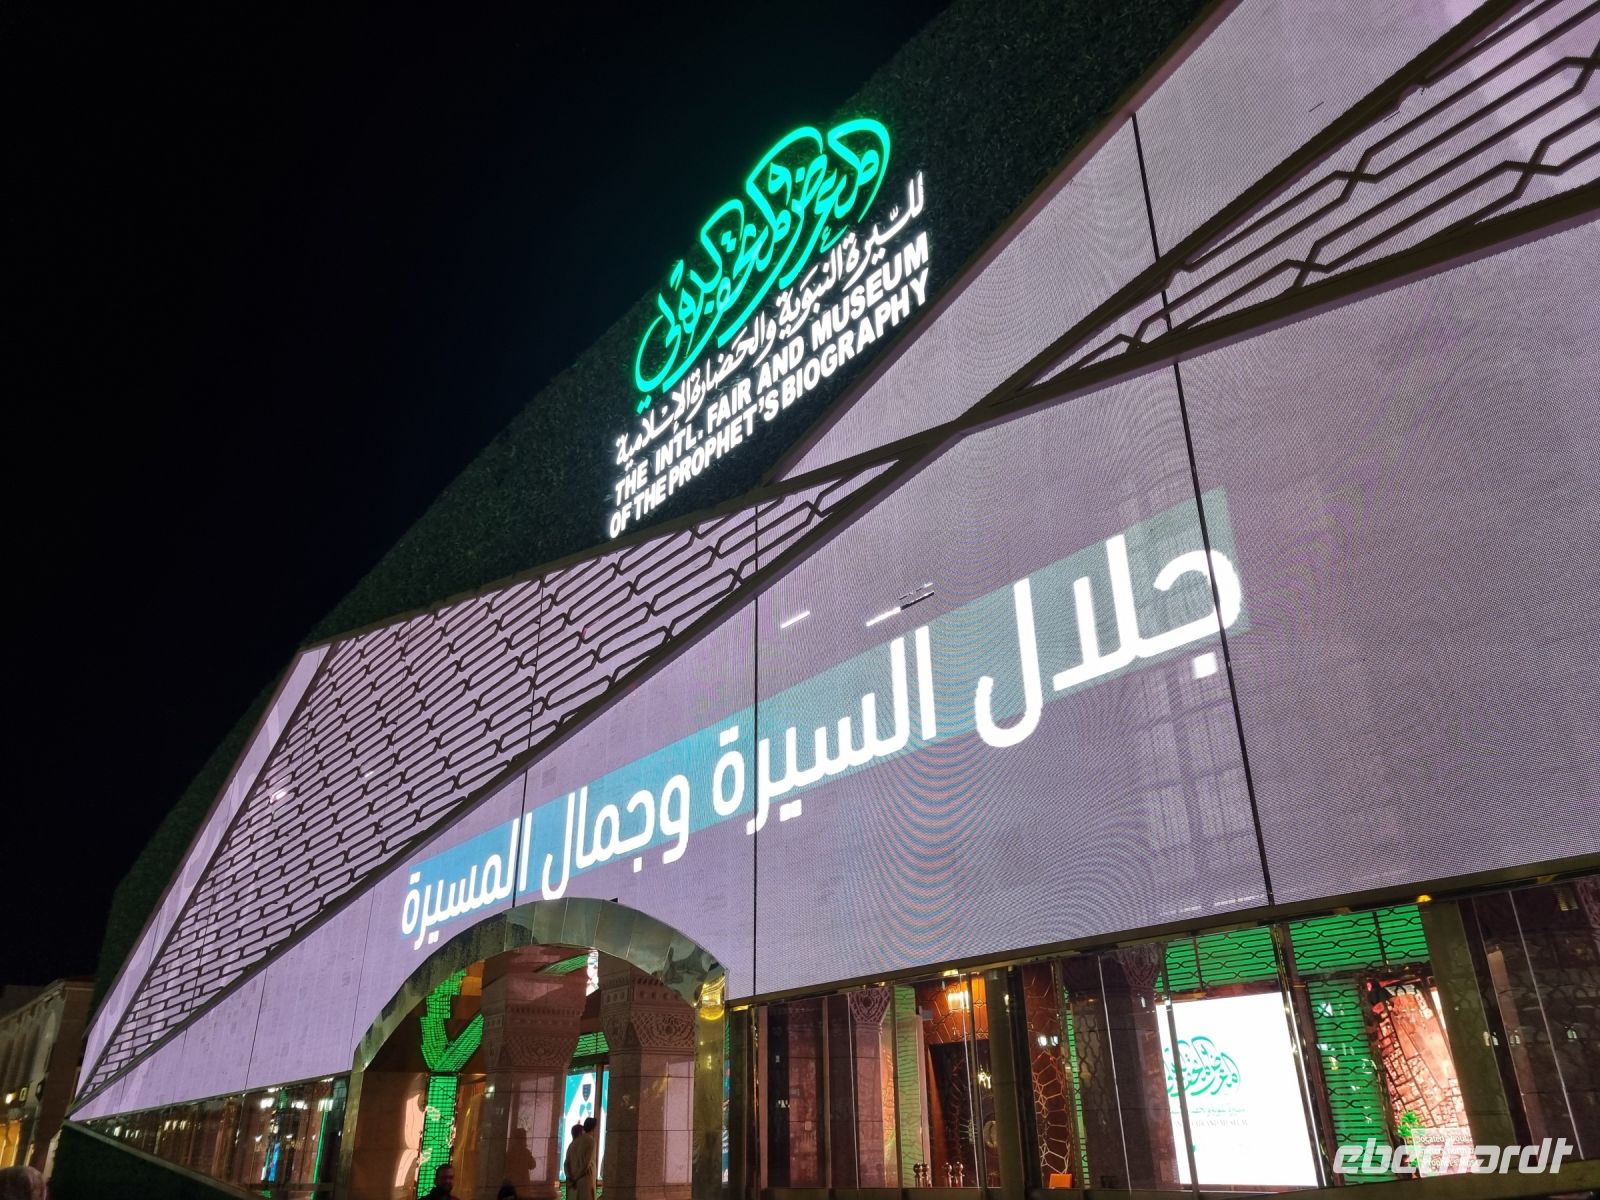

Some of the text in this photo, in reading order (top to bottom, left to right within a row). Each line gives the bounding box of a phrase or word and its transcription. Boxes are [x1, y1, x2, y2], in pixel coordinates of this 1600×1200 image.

[609, 267, 929, 539] OF THE PROPHET'S BIOGRAPHY
[615, 231, 929, 507] THE INTL. FAIR AND MUSEUM
[776, 244, 844, 341] النبوية
[400, 533, 1243, 951] جلال السيرة وجمال المسيرة
